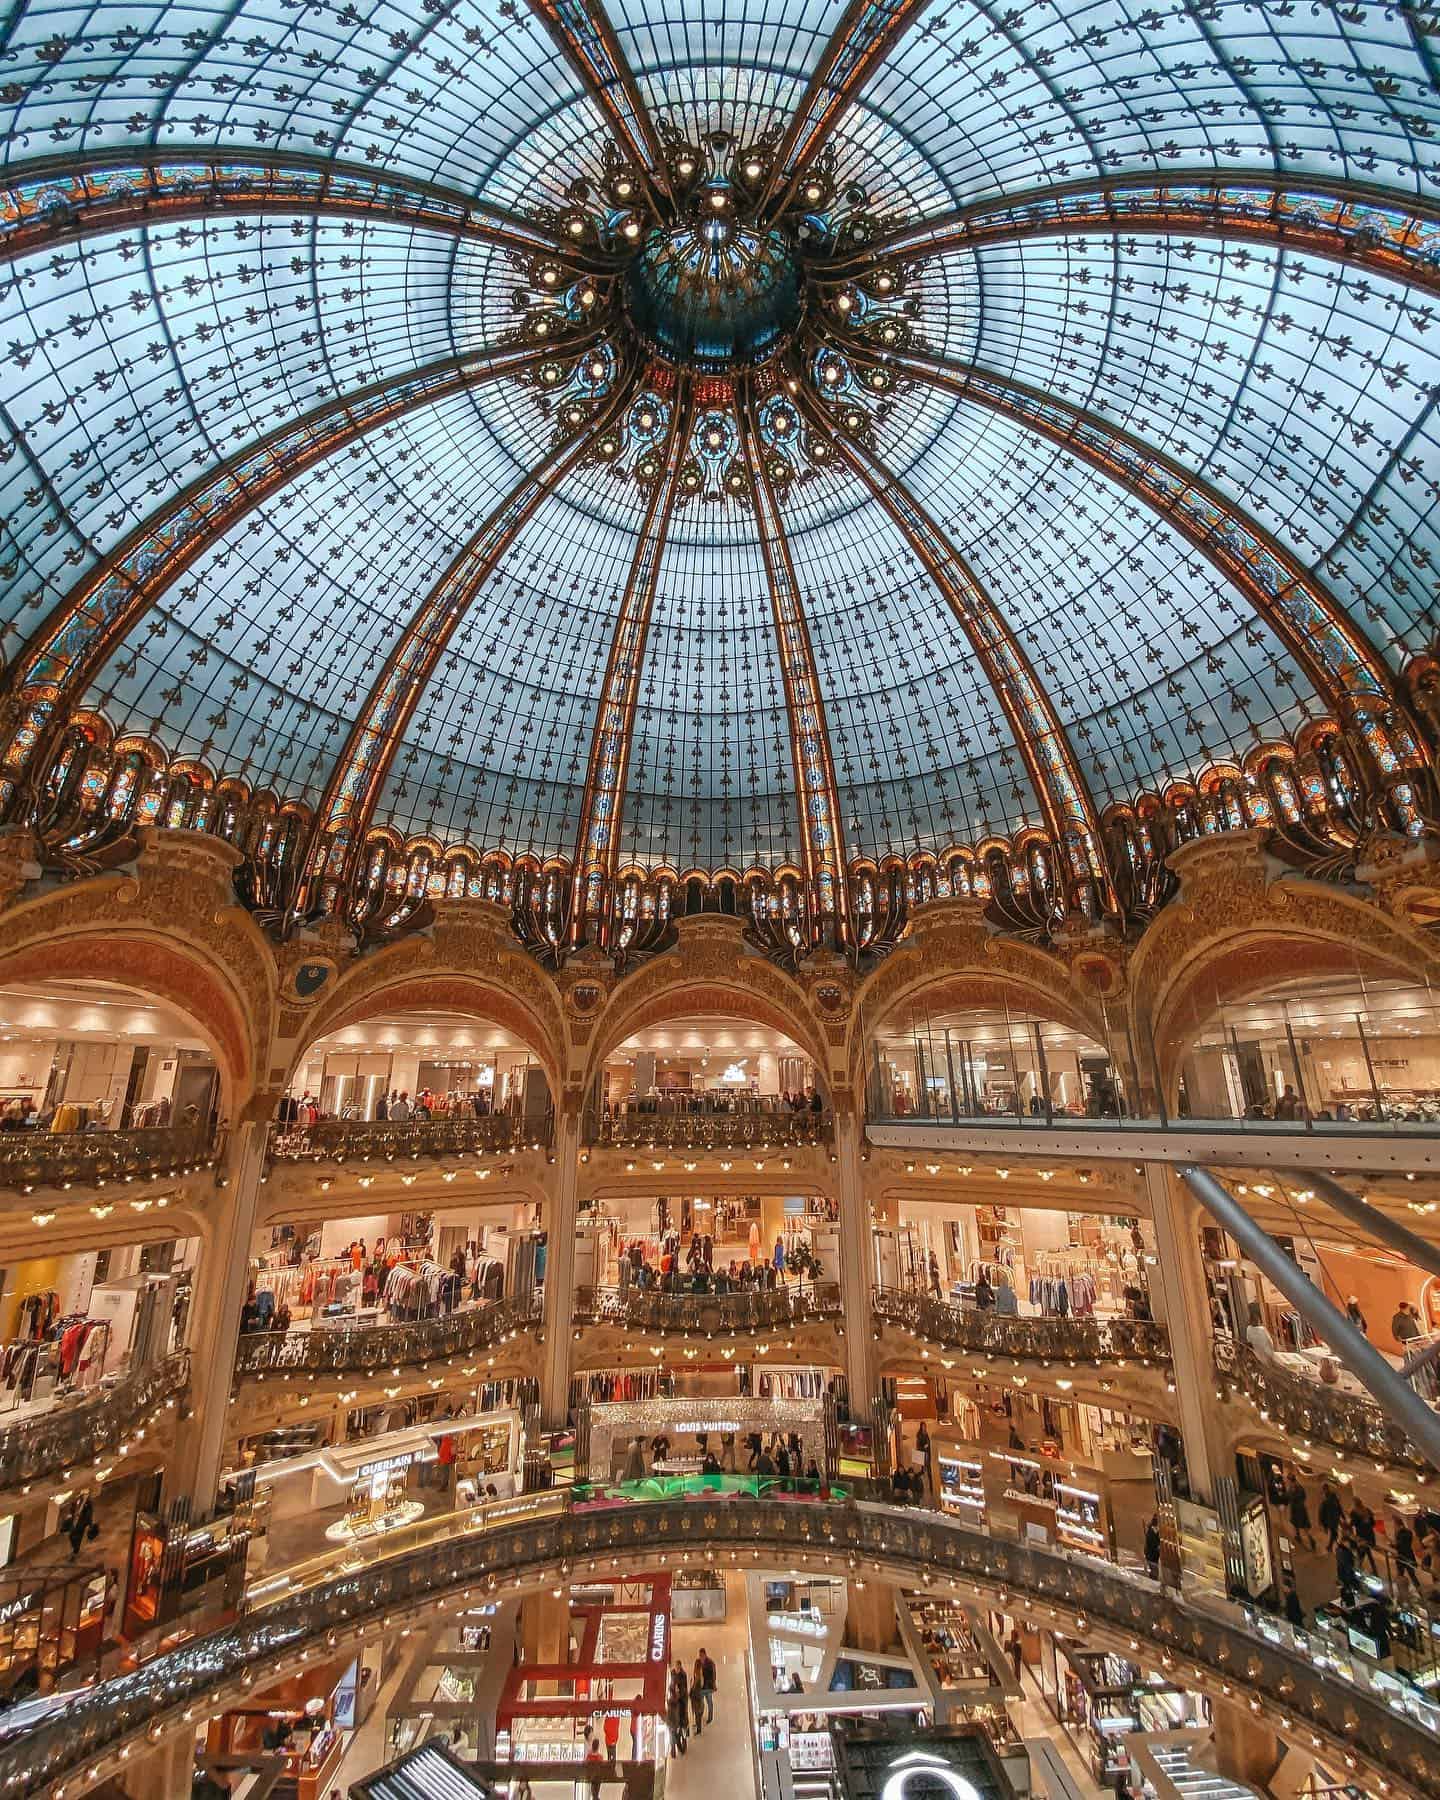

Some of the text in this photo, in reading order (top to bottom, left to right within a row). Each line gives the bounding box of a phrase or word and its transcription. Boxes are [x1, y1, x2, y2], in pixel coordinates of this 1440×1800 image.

[675, 1422, 741, 1433] LOUIS VUITTON
[361, 1454, 413, 1475] GUERLAIN
[652, 1614, 665, 1661] CLARINS
[592, 1709, 632, 1719] CLARINS
